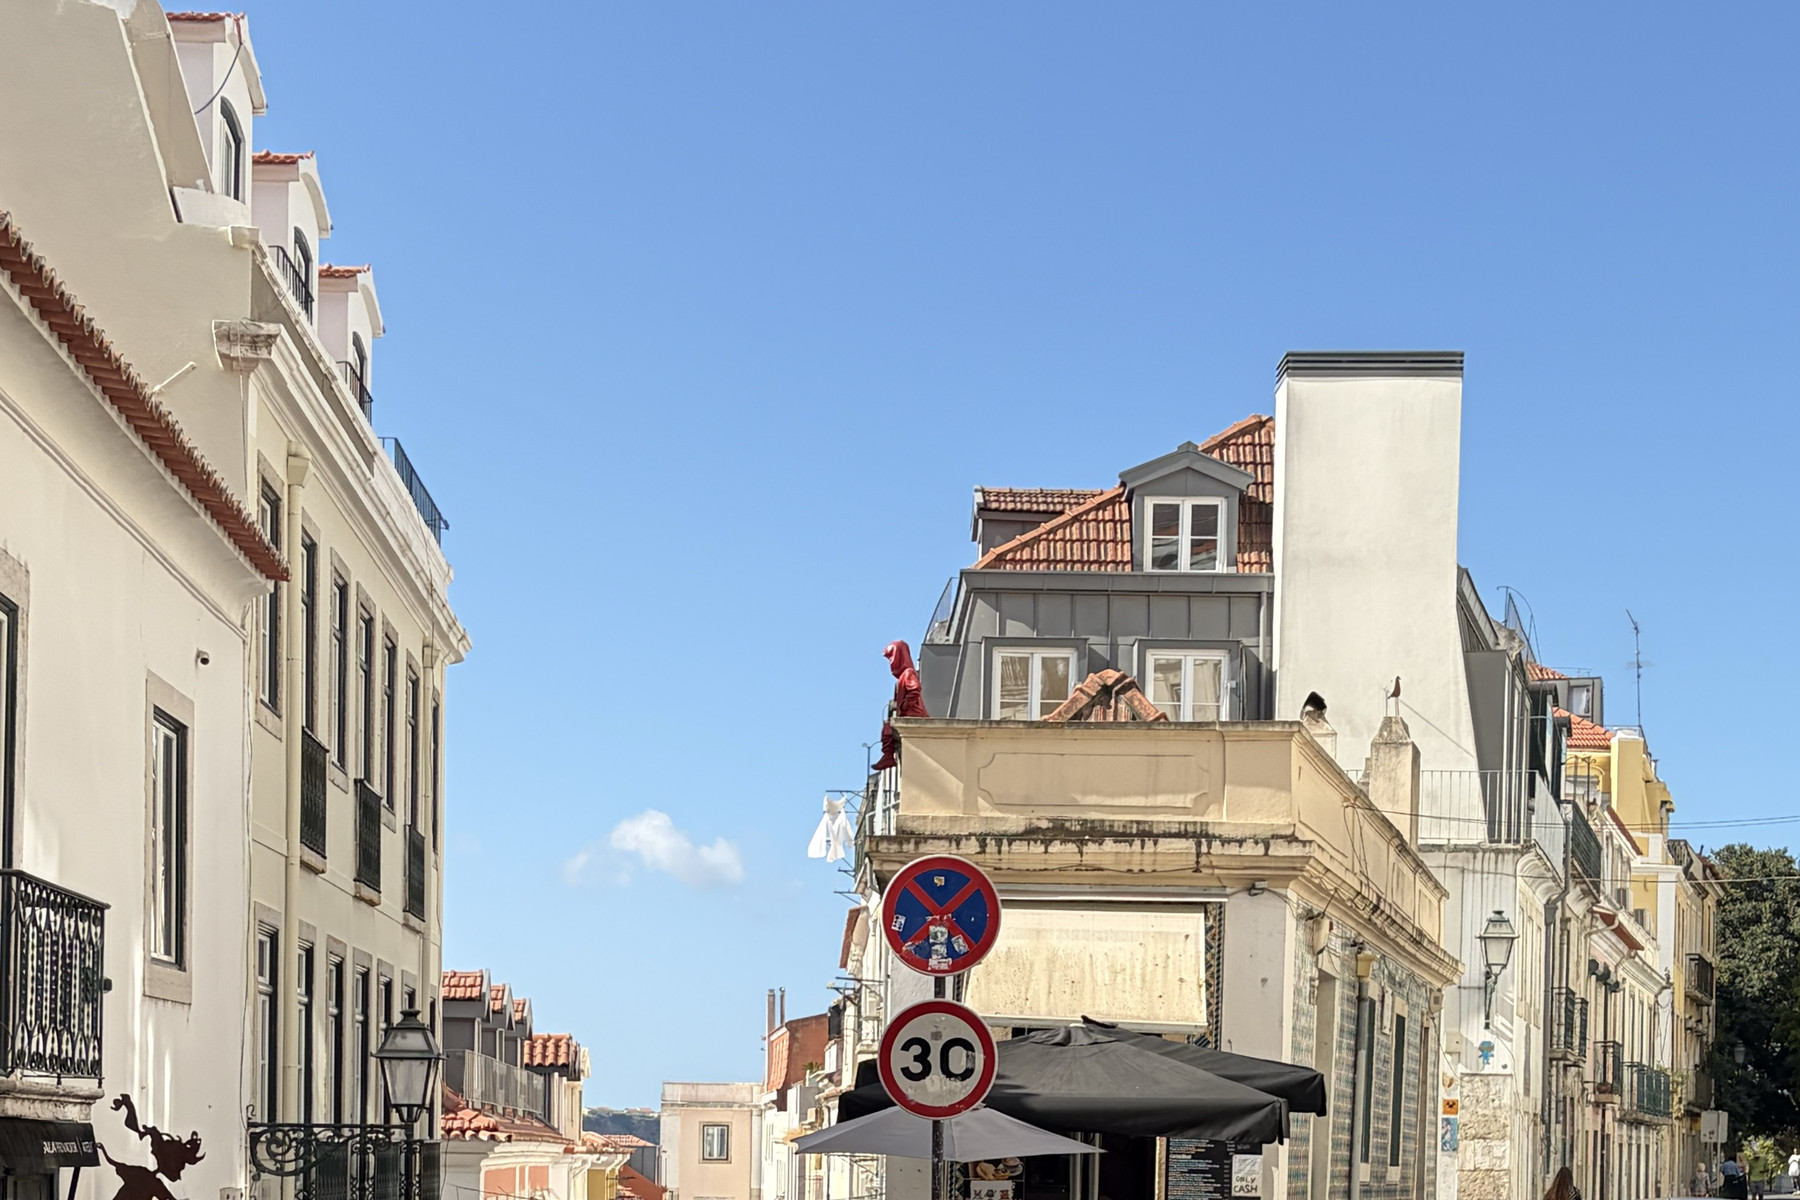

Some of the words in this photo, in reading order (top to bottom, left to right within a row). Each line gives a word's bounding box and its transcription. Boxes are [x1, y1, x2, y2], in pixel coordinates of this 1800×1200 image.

[900, 1037, 976, 1082] 30
[1235, 1175, 1256, 1184] ONLY
[1233, 1184, 1258, 1194] CASH
